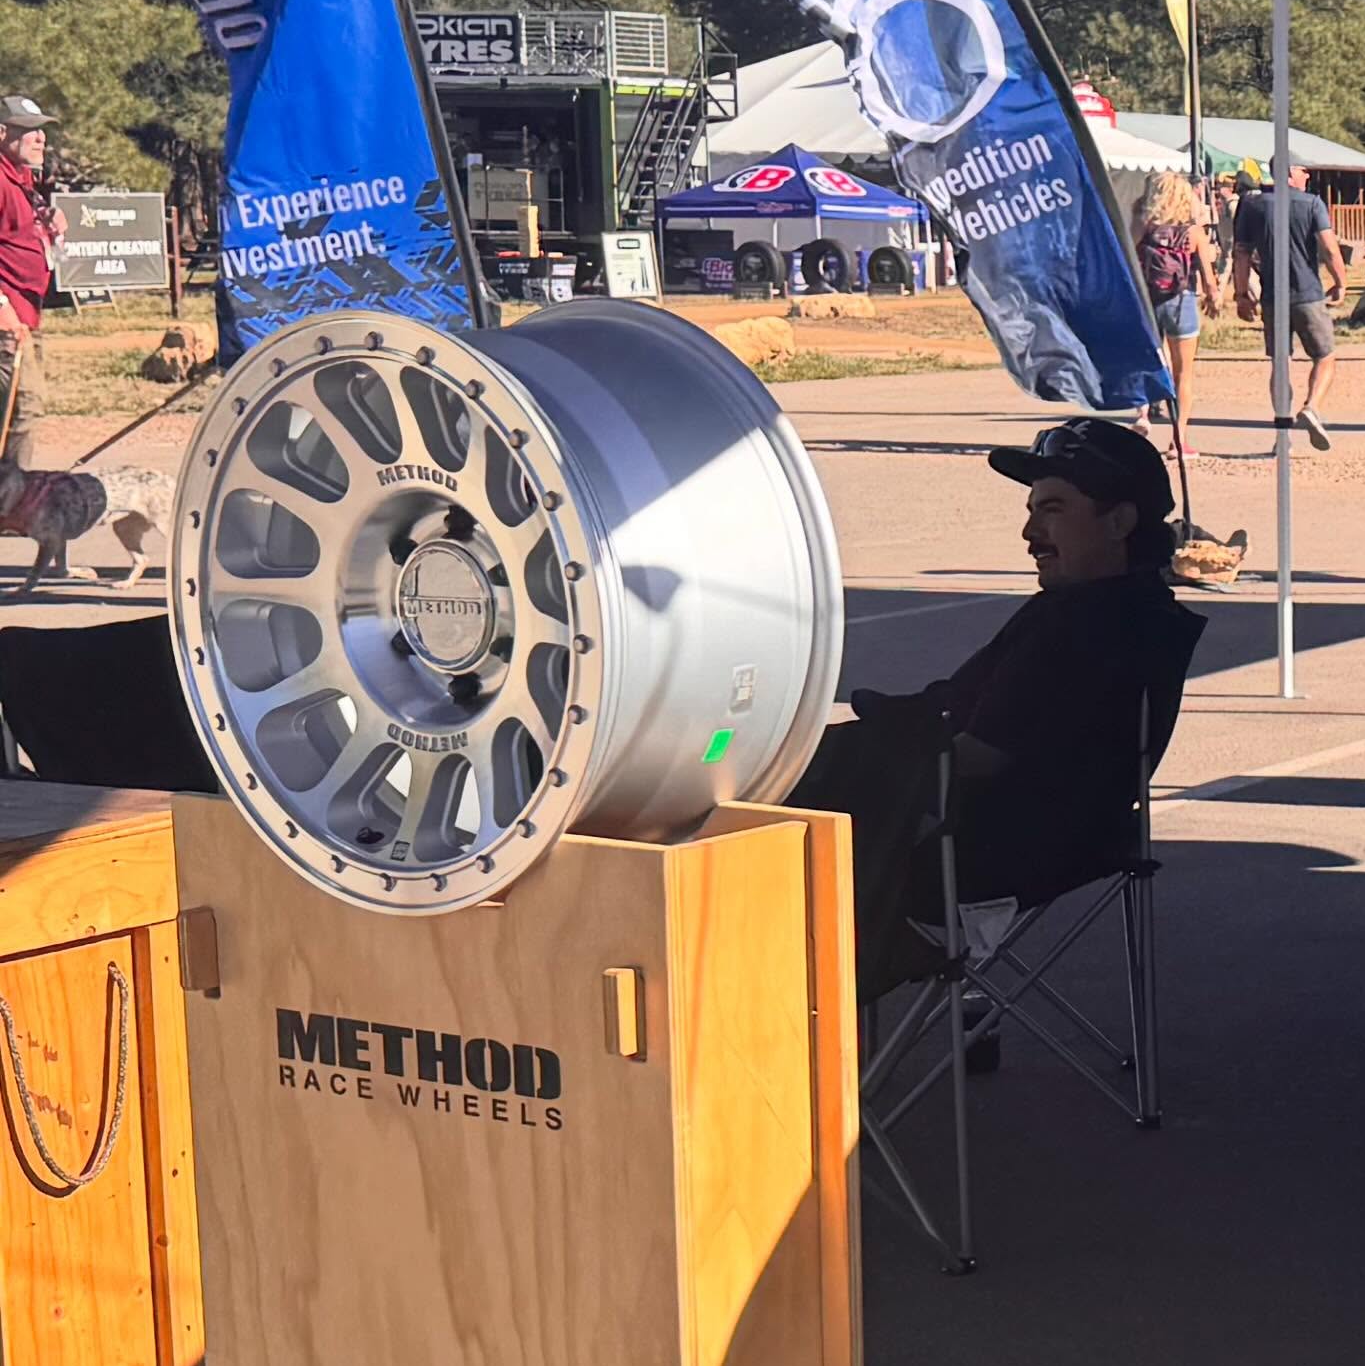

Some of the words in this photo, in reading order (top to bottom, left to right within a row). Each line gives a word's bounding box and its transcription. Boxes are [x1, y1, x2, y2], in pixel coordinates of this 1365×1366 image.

[236, 176, 406, 231] Experience
[94, 259, 127, 275] AREA
[376, 464, 459, 493] METHOD
[404, 598, 482, 616] METHOD
[386, 723, 469, 754] METHOD
[275, 1007, 562, 1101] METHOD
[278, 1064, 374, 1100] RACE
[396, 1082, 564, 1132] WHEELS
